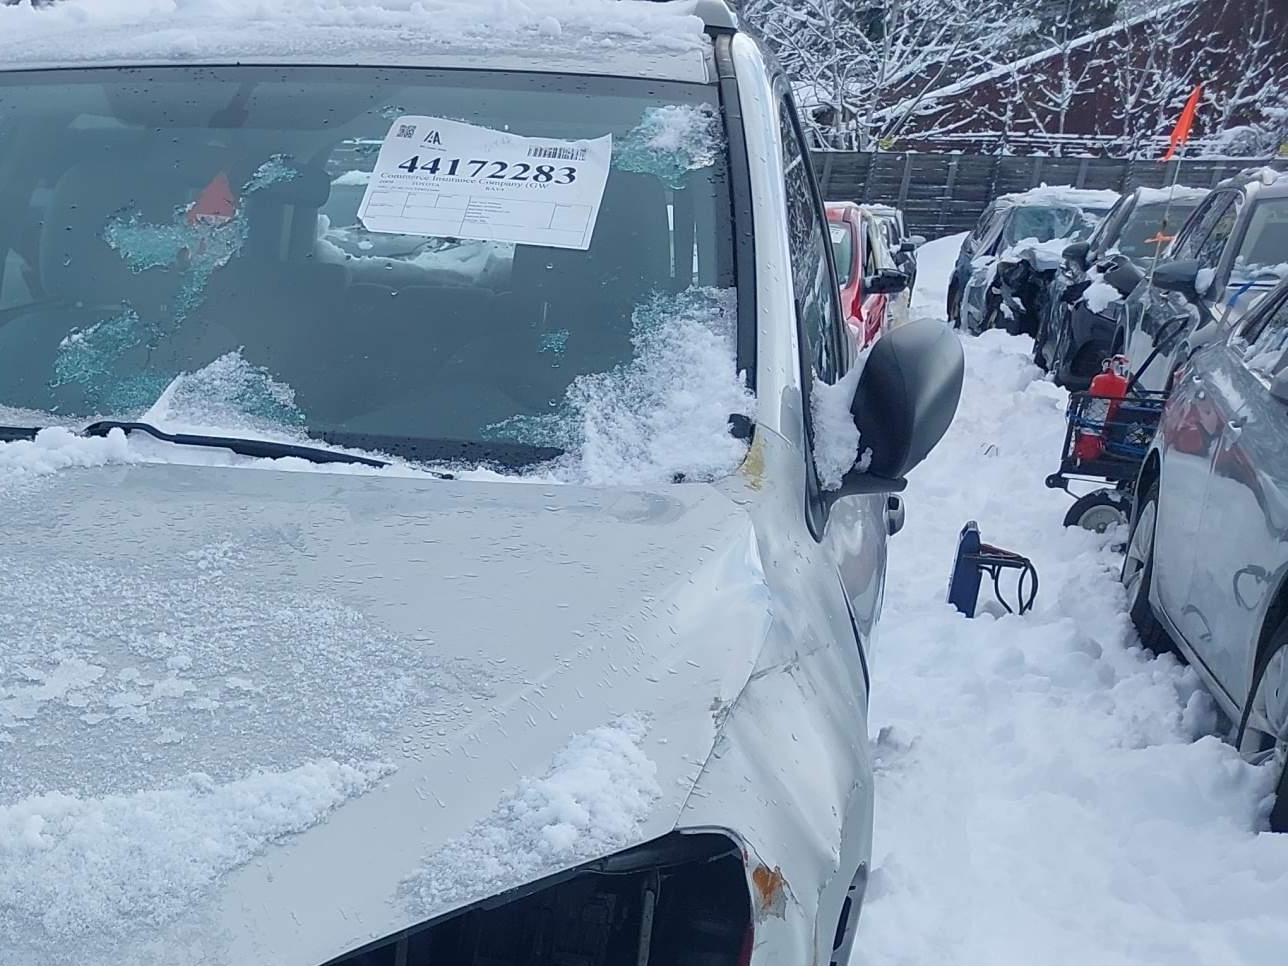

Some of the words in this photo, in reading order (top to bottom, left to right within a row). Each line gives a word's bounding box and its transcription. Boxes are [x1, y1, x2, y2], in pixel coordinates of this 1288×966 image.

[380, 172, 430, 181] Commerce
[432, 175, 476, 184] Insurance
[478, 178, 523, 189] Company
[397, 155, 578, 185] 44172283
